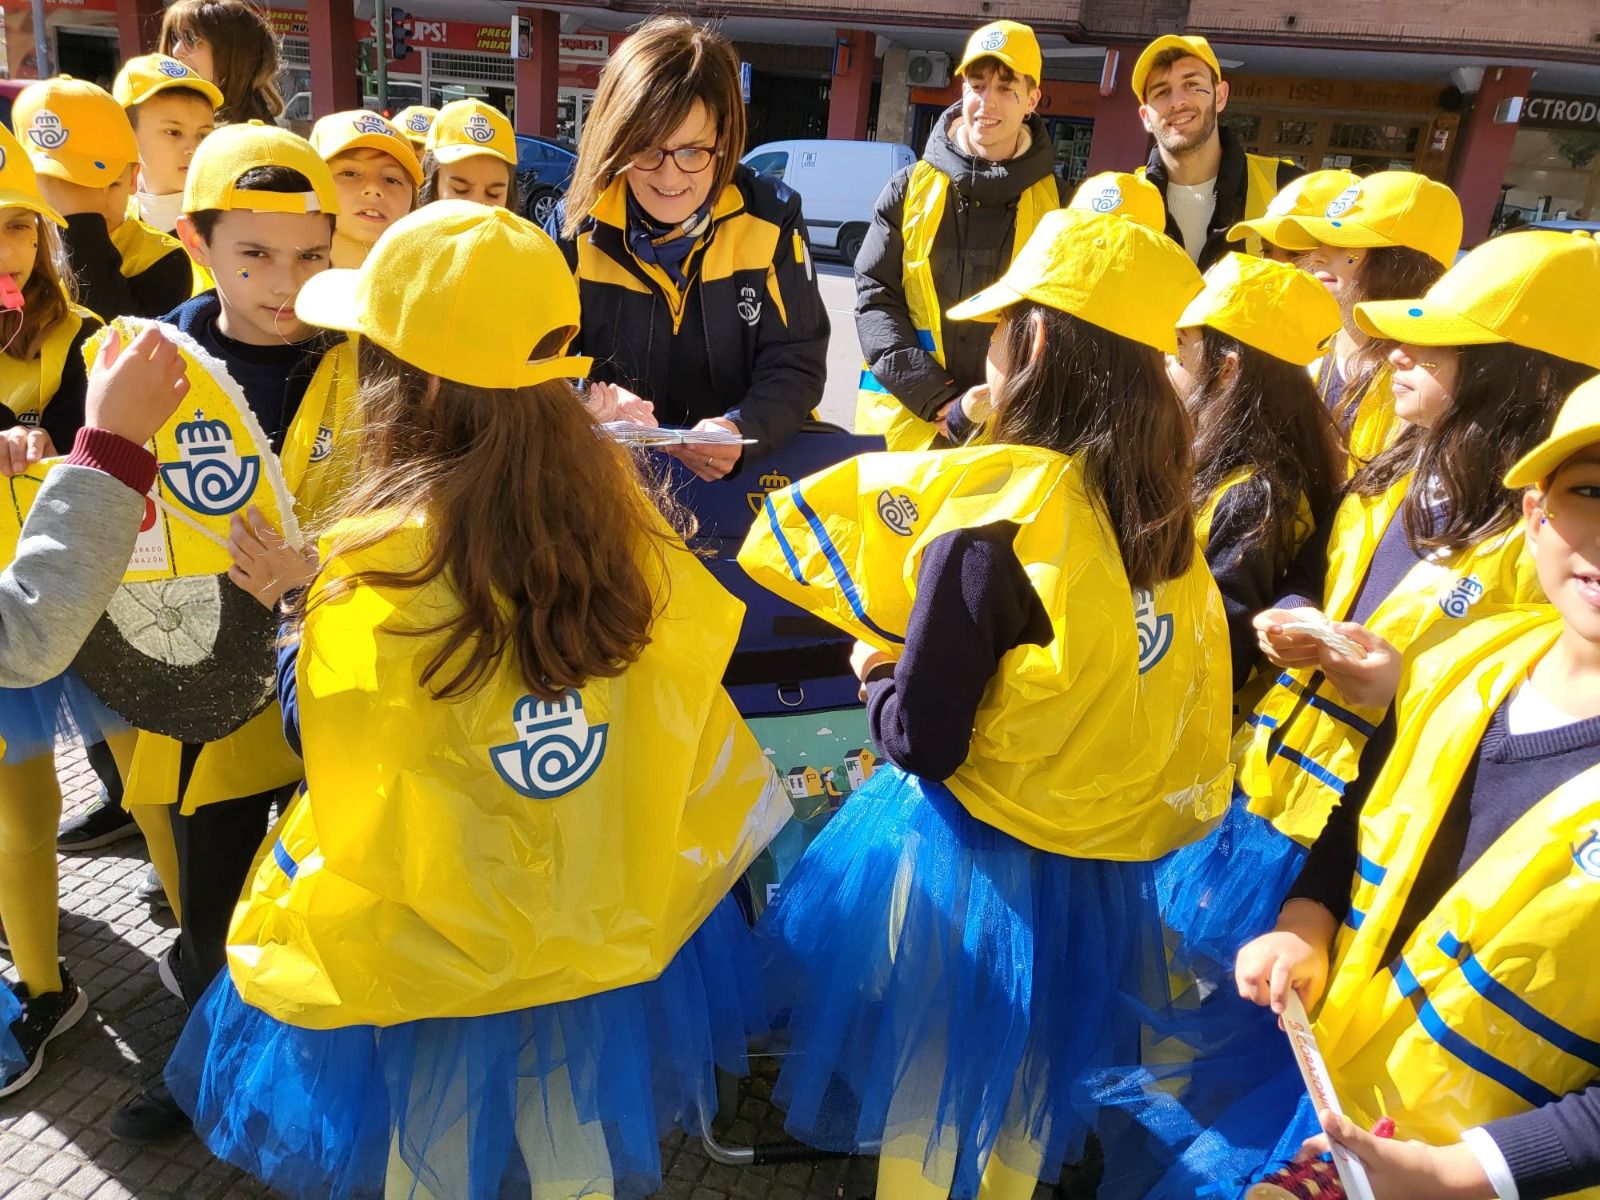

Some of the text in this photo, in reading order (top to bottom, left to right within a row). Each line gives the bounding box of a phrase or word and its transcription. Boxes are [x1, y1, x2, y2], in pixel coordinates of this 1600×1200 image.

[292, 24, 310, 33] MU
[476, 27, 512, 38] ¡PRECI
[477, 39, 512, 50] IMBAT
[1288, 83, 1334, 101] 1984
[1520, 97, 1600, 122] CTROD
[129, 556, 164, 564] ORAZÓN
